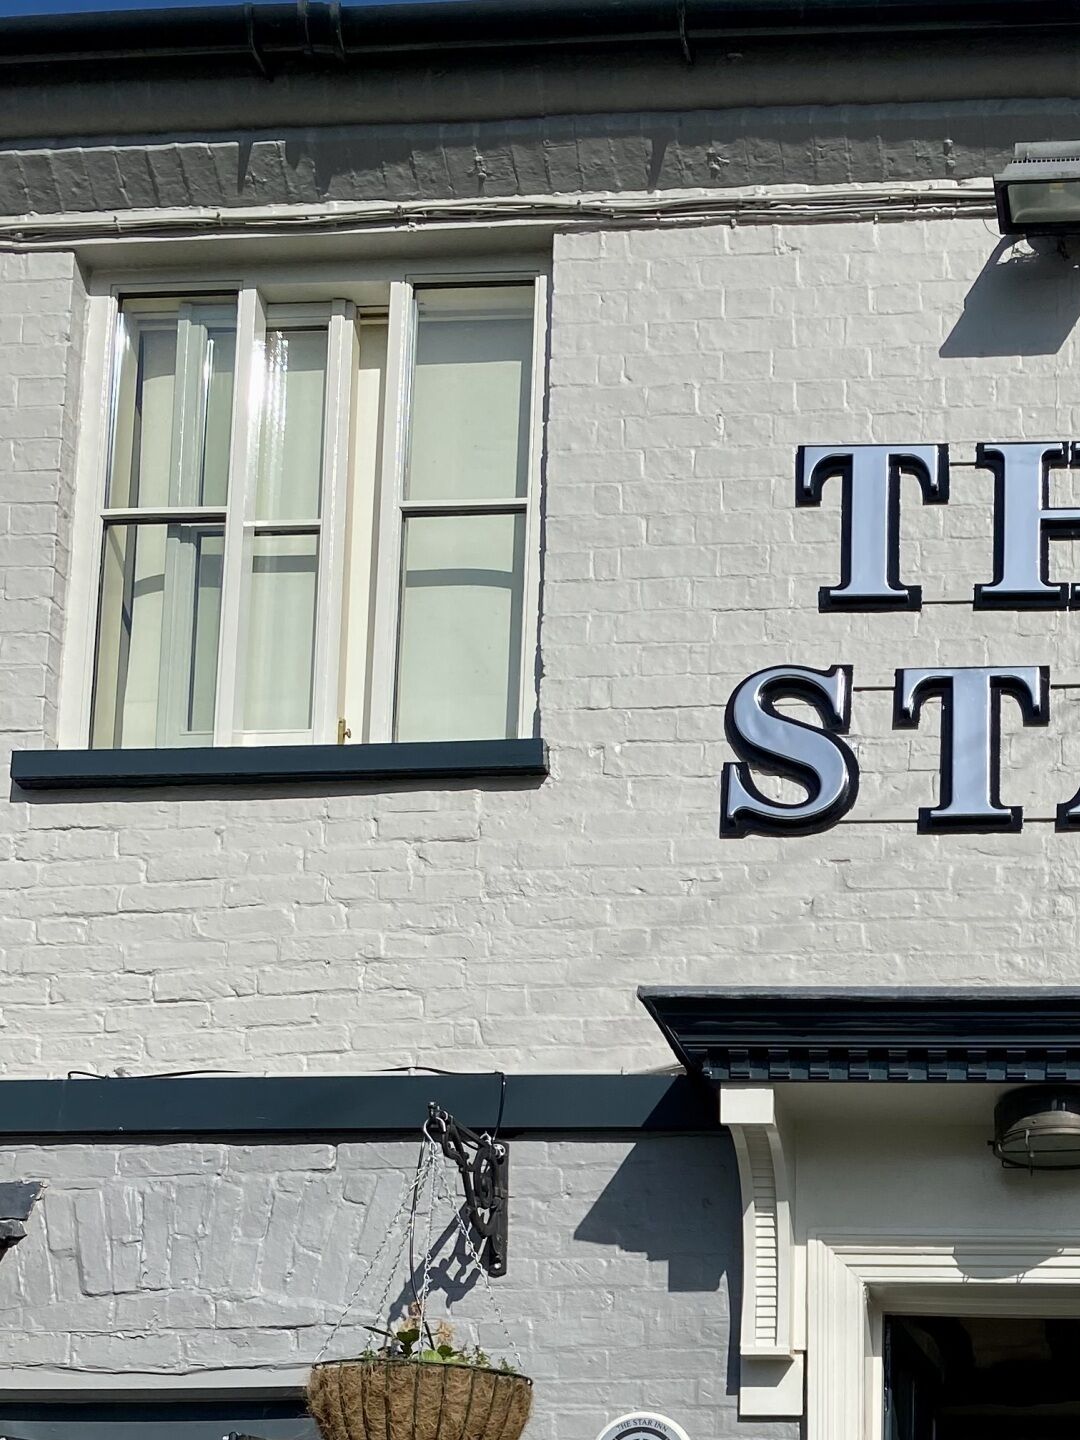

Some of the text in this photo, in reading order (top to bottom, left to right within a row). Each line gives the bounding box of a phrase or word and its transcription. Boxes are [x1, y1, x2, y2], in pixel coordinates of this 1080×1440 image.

[616, 1418, 669, 1432] THE STAR INN
